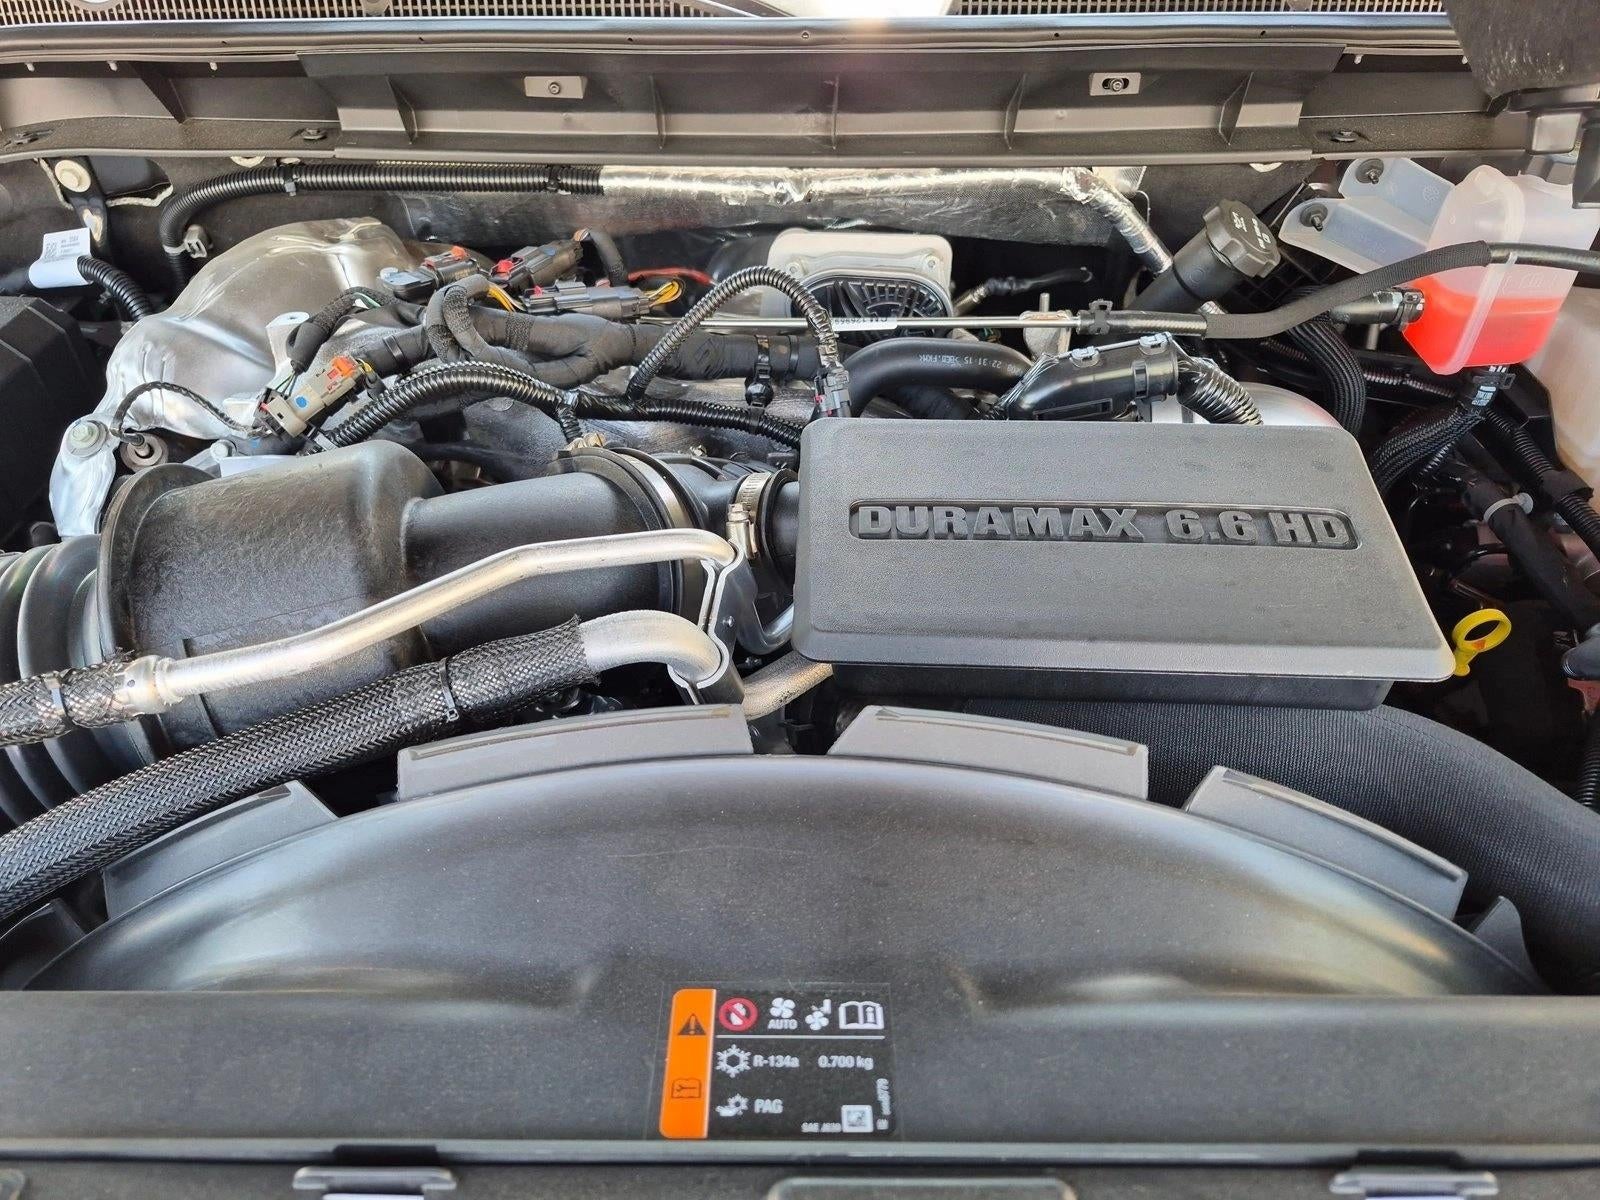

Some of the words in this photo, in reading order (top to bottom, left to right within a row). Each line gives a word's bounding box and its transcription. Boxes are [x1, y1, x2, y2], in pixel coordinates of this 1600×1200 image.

[858, 506, 1144, 543] DURAMAX
[1164, 509, 1258, 546] 6.6
[1268, 511, 1352, 548] HD
[768, 1018, 798, 1030] AUTO
[753, 1054, 800, 1068] R-134a
[818, 1055, 855, 1069] 0.700
[856, 1055, 874, 1071] kg
[754, 1098, 783, 1114] PAG
